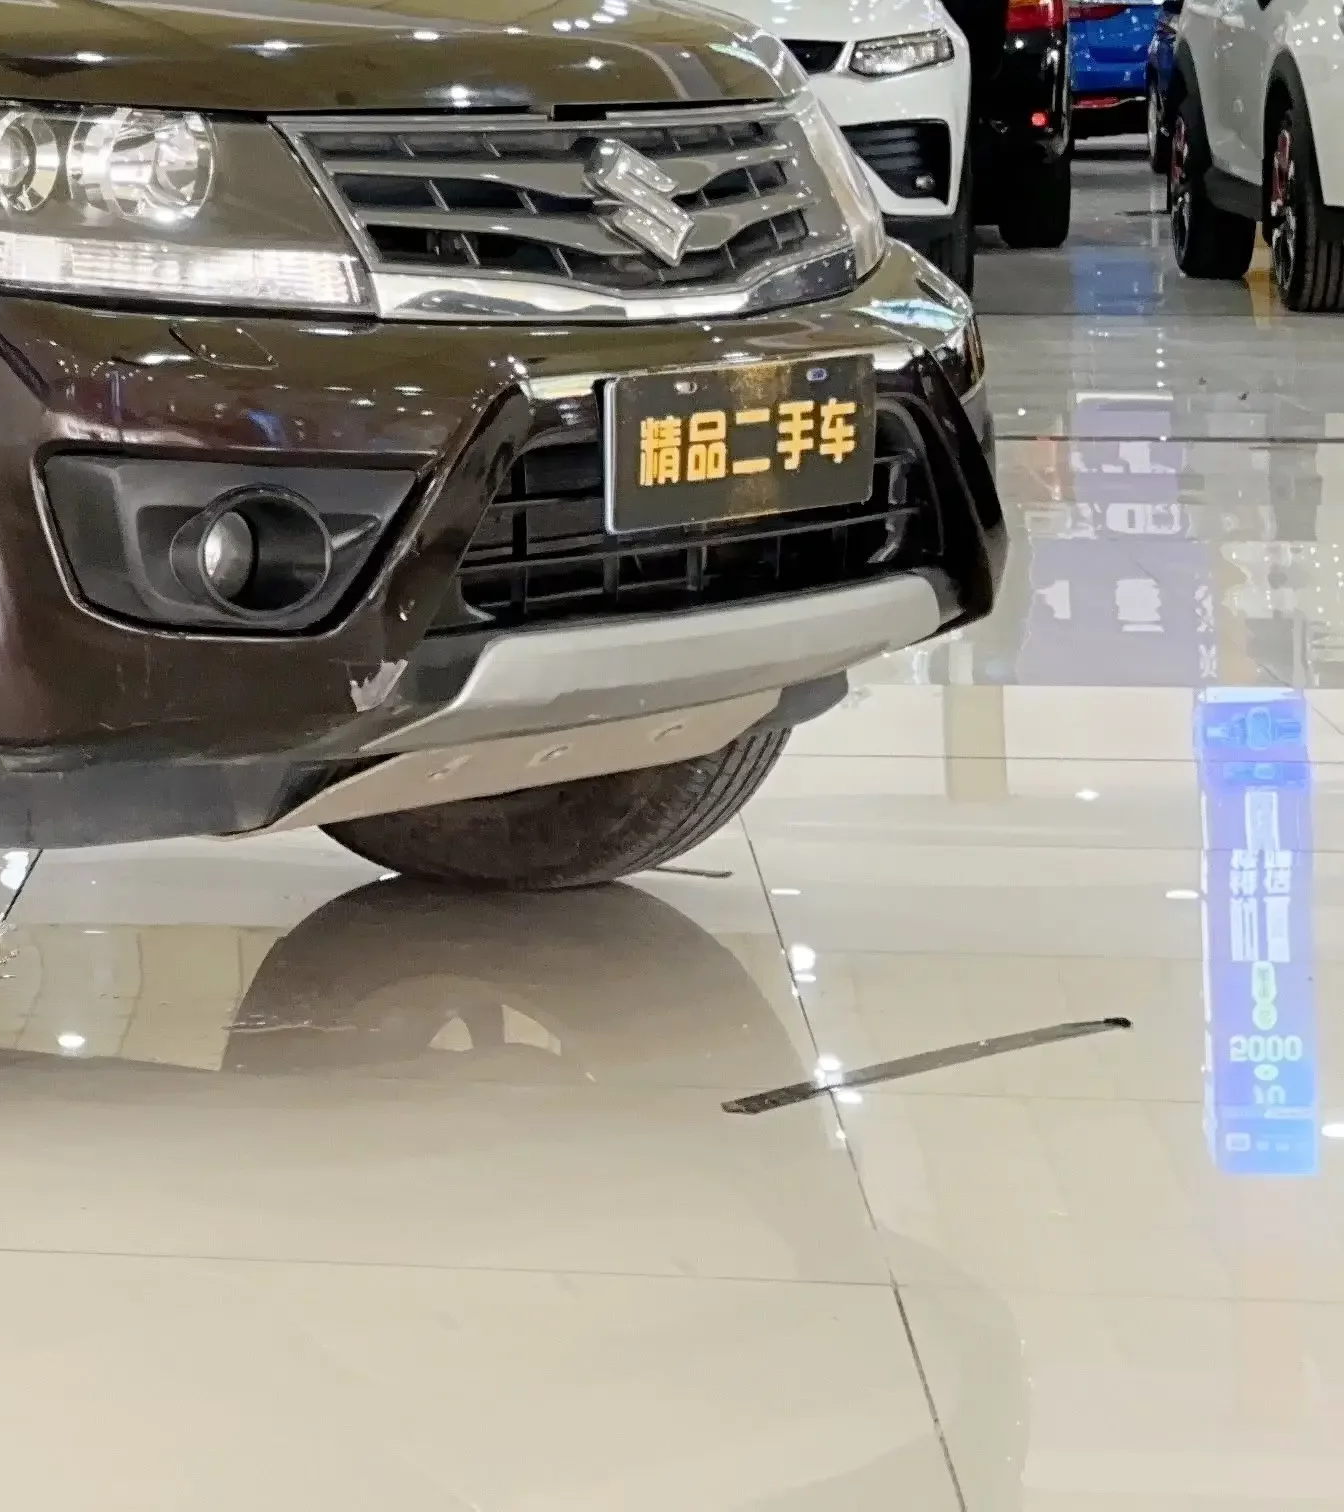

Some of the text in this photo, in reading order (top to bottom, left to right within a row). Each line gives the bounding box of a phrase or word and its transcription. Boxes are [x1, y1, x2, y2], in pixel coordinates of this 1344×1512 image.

[639, 397, 857, 487] 精品二手车
